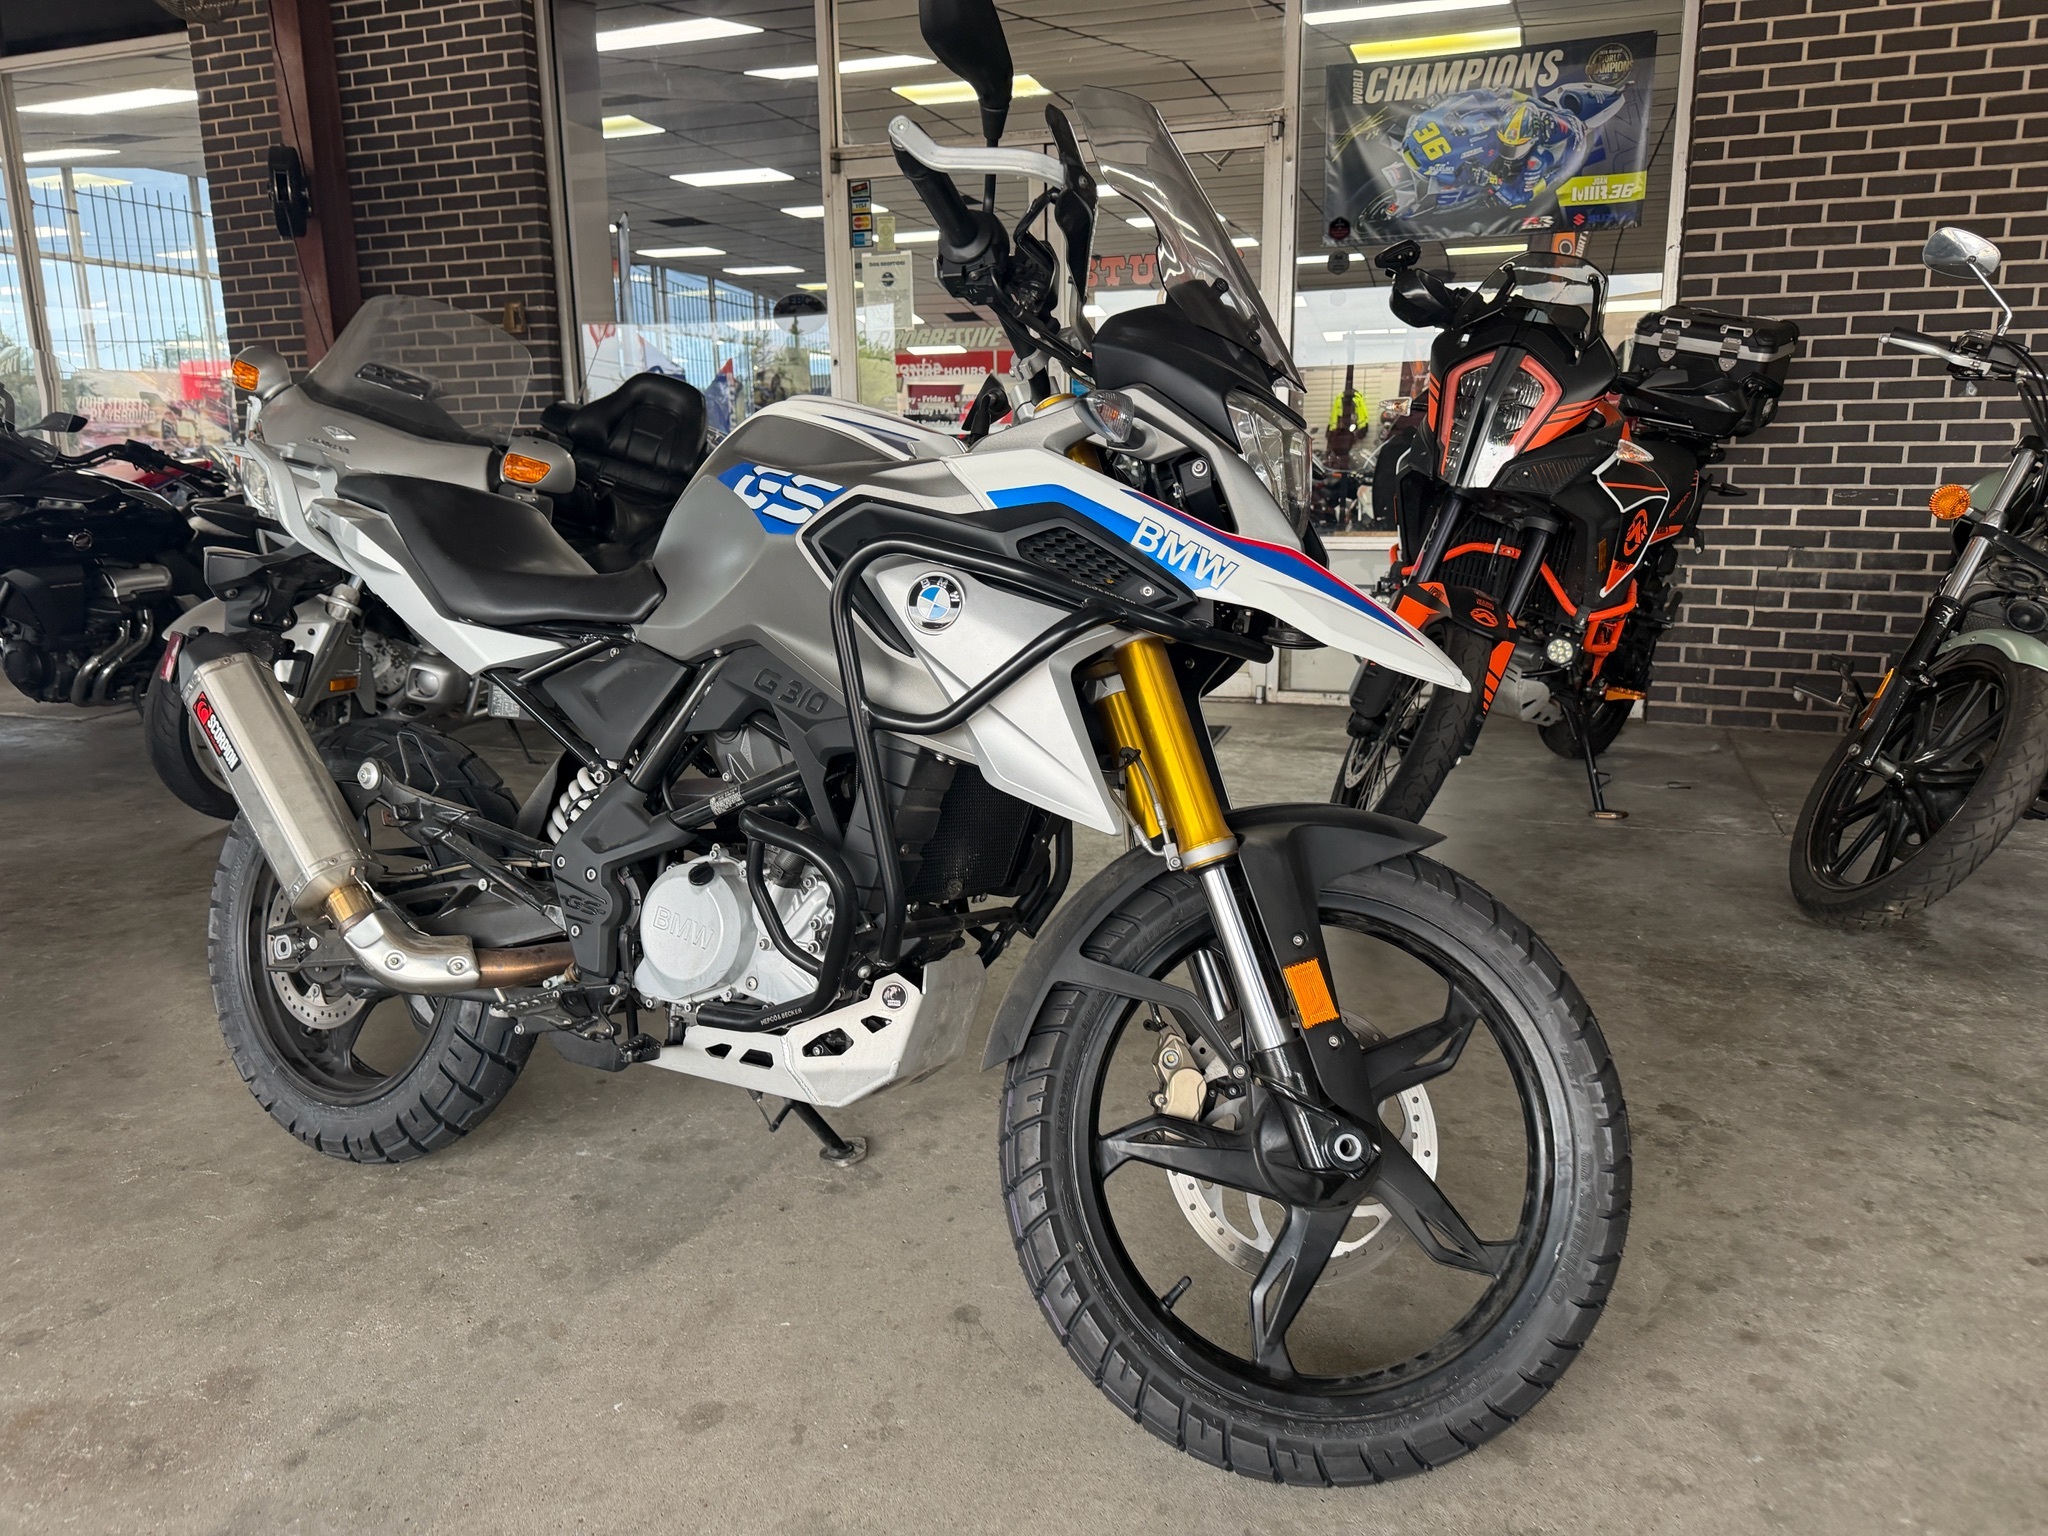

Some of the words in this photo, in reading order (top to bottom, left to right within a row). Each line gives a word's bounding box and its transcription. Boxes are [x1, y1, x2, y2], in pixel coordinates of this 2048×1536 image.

[1352, 69, 1364, 105] WORLD
[1365, 49, 1564, 104] CHAMPIONS
[1412, 121, 1452, 161] 36
[879, 326, 1003, 349] PROGRESSIVE
[944, 366, 987, 377] HOURS
[76, 396, 105, 410] YOUR
[106, 397, 151, 413] STREETS
[922, 395, 947, 403] Friday
[733, 465, 843, 524] GS
[1130, 516, 1239, 591] BMW
[753, 668, 782, 696] G
[778, 679, 829, 715] 310
[207, 713, 239, 770] SCORPION
[652, 905, 715, 950] BMW
